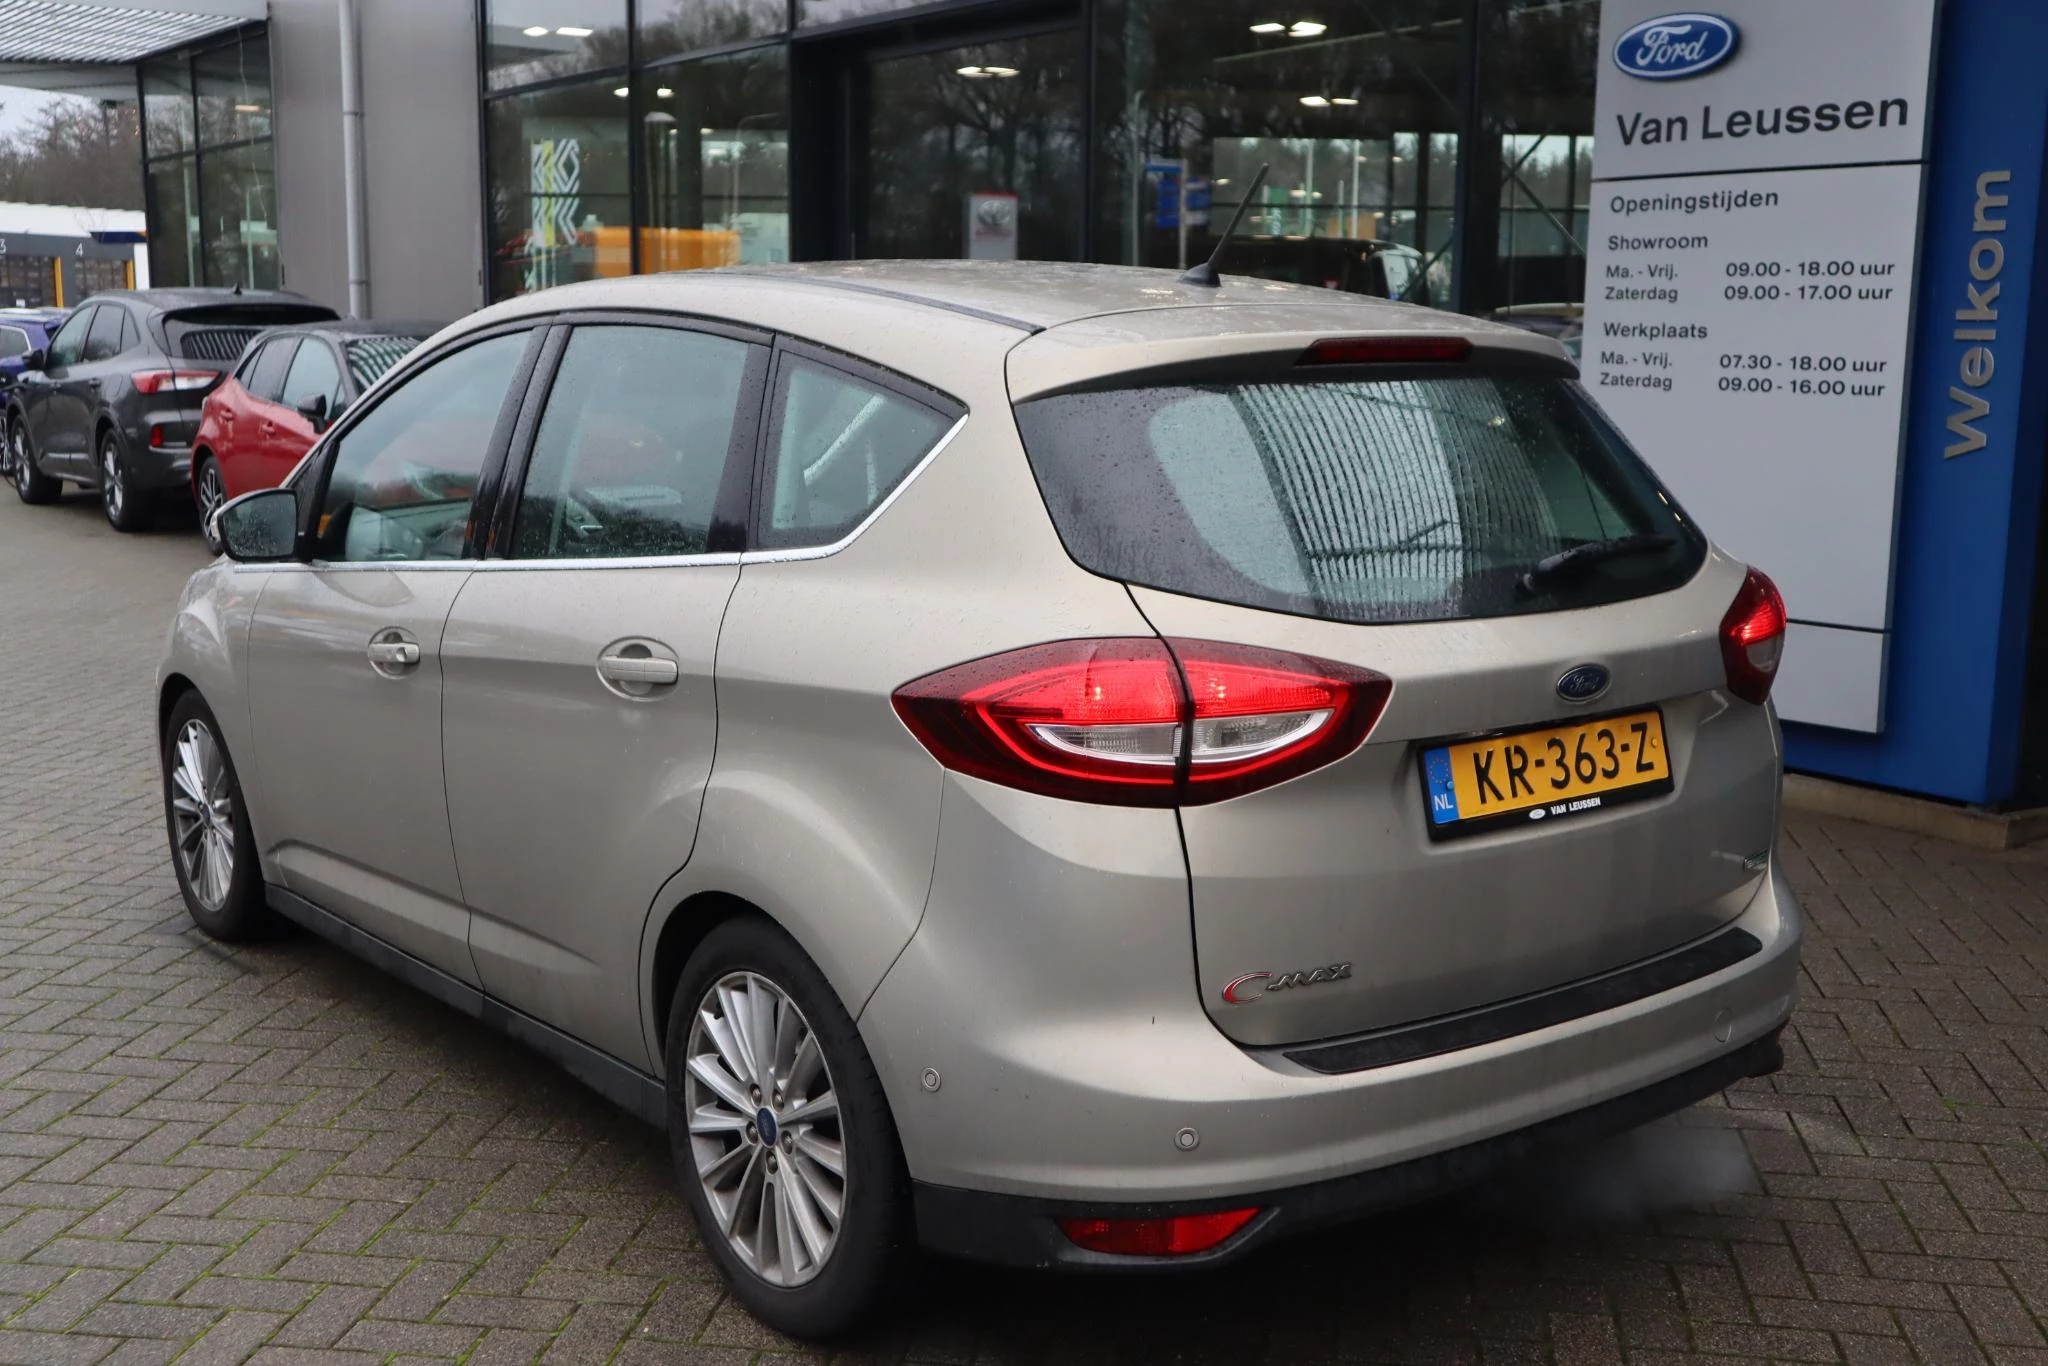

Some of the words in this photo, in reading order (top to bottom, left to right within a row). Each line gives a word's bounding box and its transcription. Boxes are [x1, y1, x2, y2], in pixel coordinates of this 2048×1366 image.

[1636, 24, 1708, 66] Ford
[1615, 111, 1689, 147] Van
[1701, 97, 1909, 141] Leussen
[1610, 190, 1779, 217] Openingstijden
[75, 242, 84, 257] 4
[1607, 234, 1709, 251] Showroom
[1605, 265, 1634, 279] Ma.
[1647, 264, 1679, 281] Vrij.
[1725, 261, 1782, 278] 09.00
[1797, 261, 1855, 277] 18.00
[1859, 263, 1896, 276] uur
[1604, 286, 1679, 304] Zaterdag
[1723, 284, 1781, 301] 09.00
[1797, 285, 1853, 301] 17.00
[1857, 287, 1894, 301] uur
[1943, 169, 2011, 459] Welkom
[1603, 322, 1708, 342] Werkplaats
[1600, 351, 1629, 366] Ma.
[1641, 352, 1673, 370] Vrij.
[1719, 354, 1773, 370] 07.30
[1789, 355, 1847, 372] 18.00
[1851, 360, 1888, 373] uur
[1599, 372, 1673, 393] Zaterdag
[1717, 376, 1773, 393] 09.00
[1789, 379, 1846, 396] 16.00
[1850, 384, 1886, 397] uur
[1473, 721, 1655, 804] KR-363-Z
[1434, 793, 1454, 811] NL
[1550, 803, 1567, 815] VAN
[1568, 797, 1601, 812] LEUSSEN
